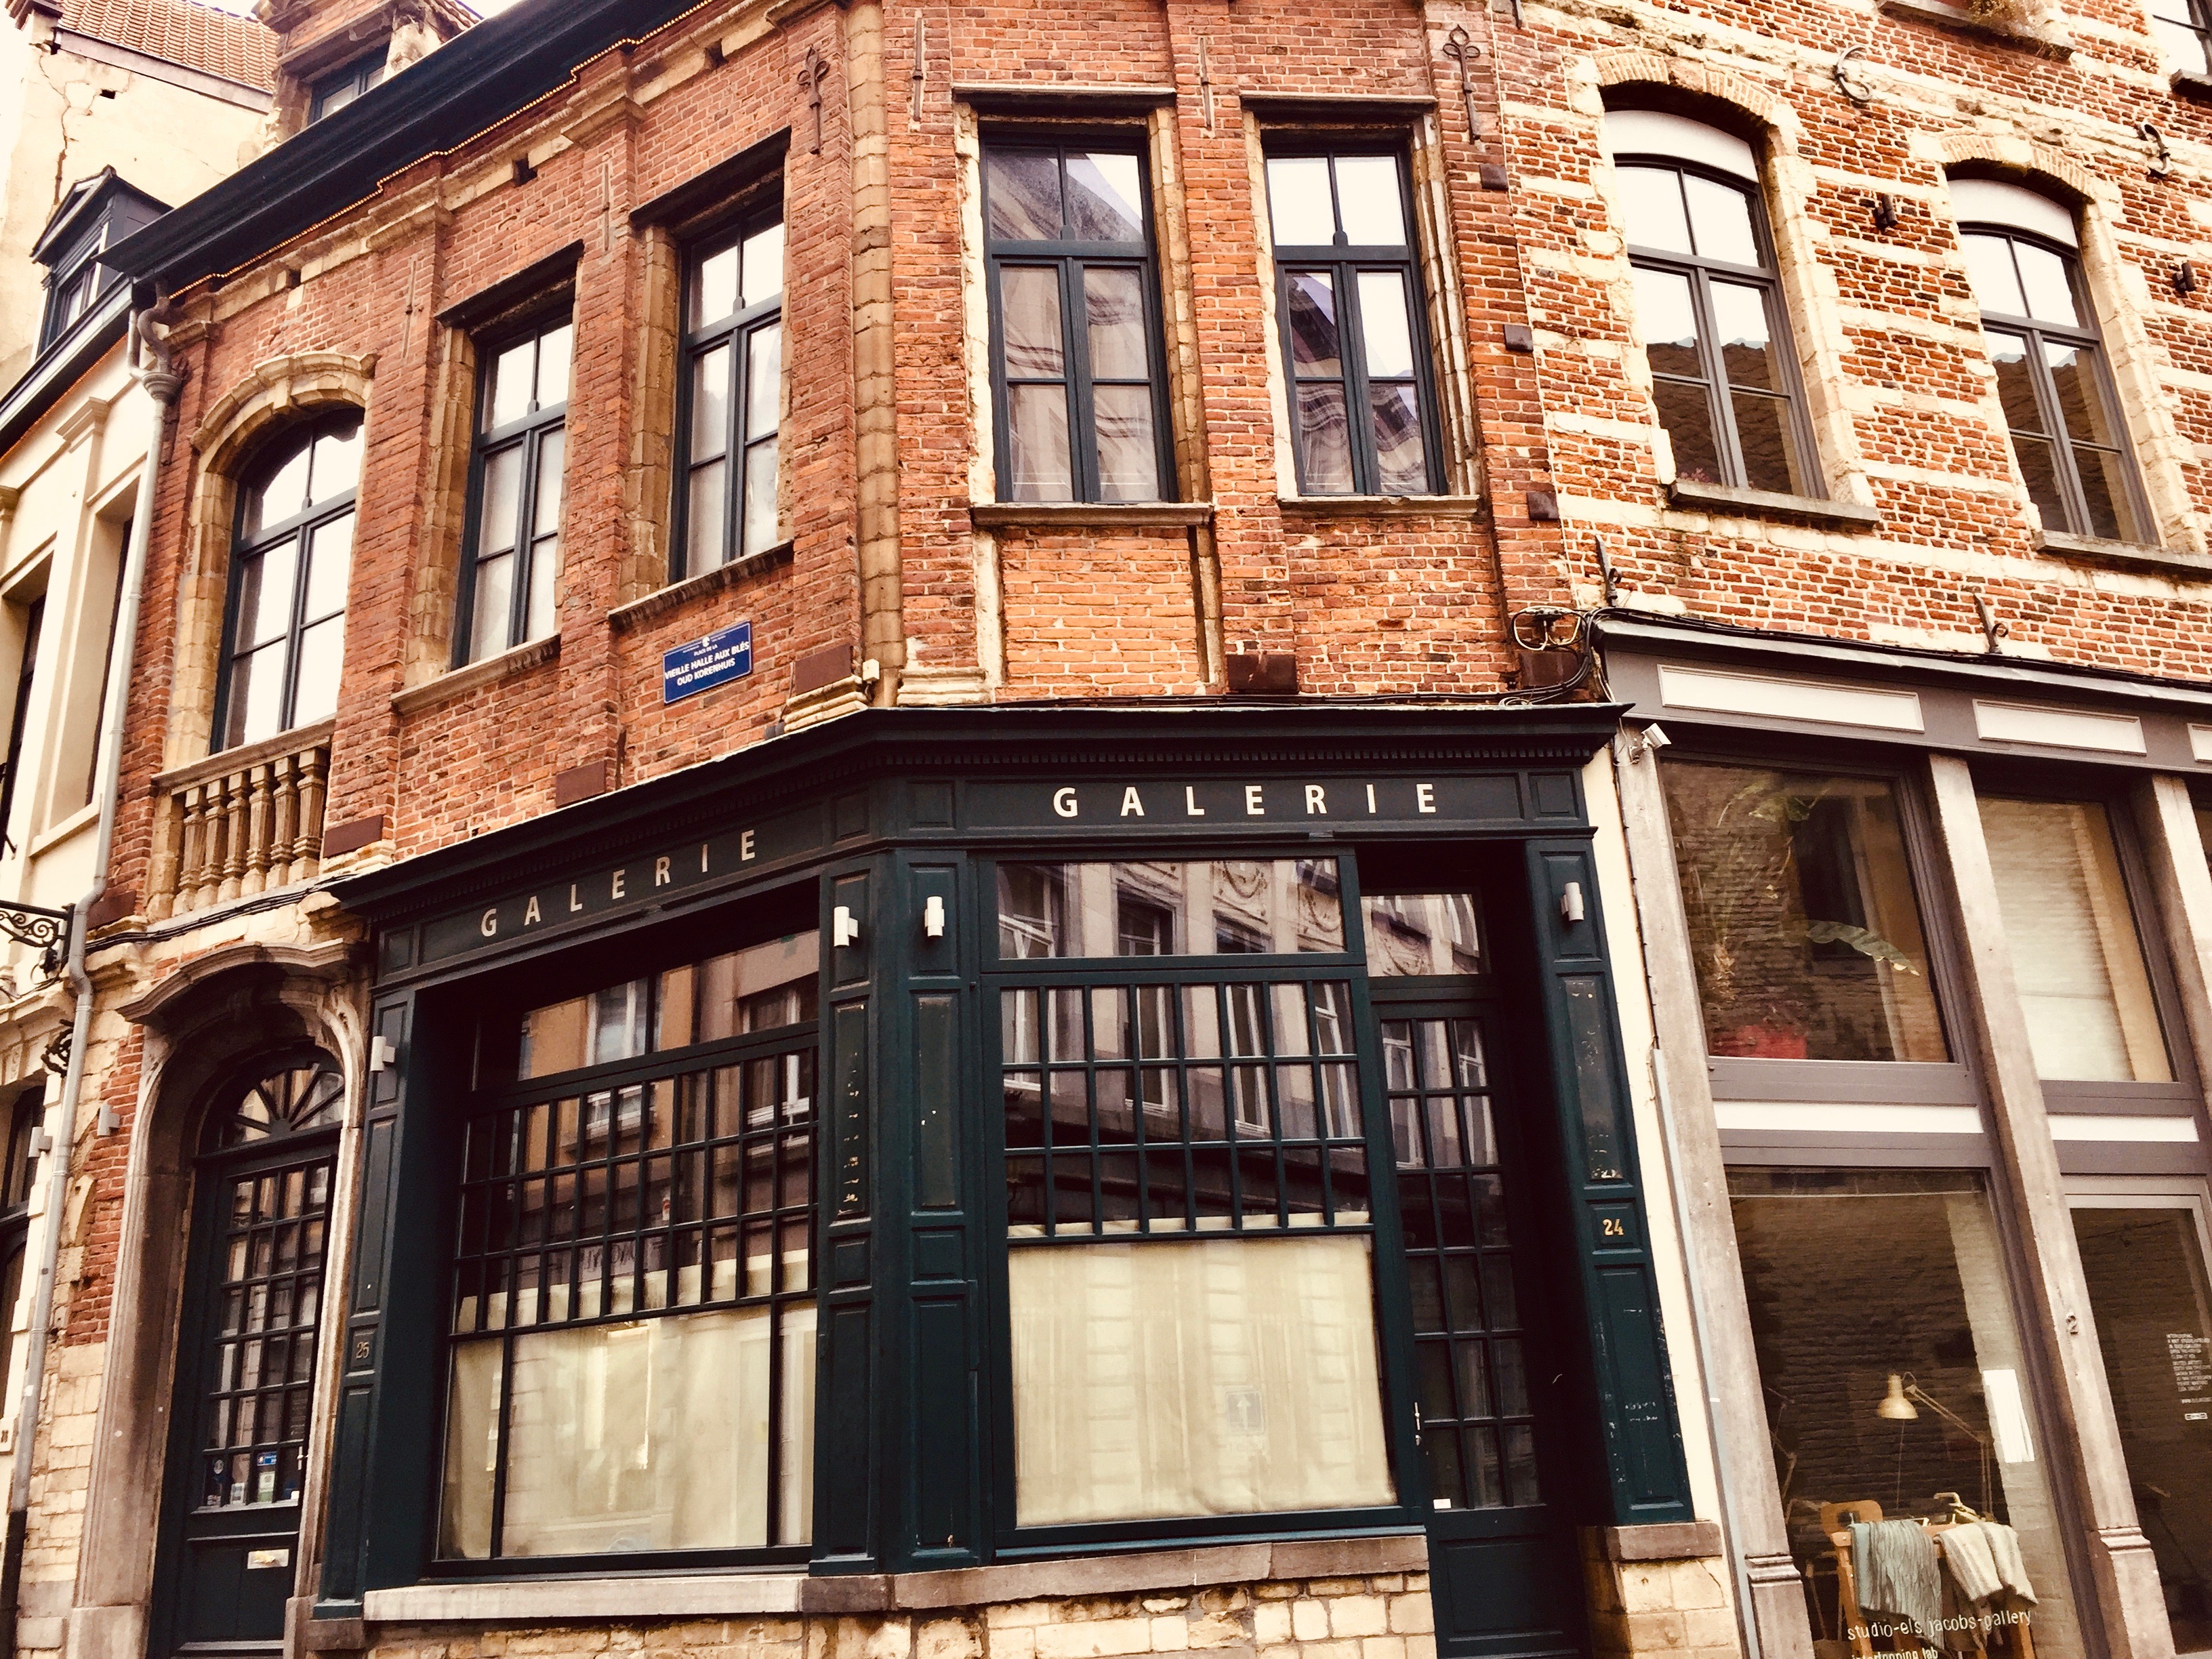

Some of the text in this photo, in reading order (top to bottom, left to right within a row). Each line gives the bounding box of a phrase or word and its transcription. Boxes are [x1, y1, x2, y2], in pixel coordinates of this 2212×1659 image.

[664, 663, 690, 680] VIEILLE
[691, 655, 714, 670] HALLE
[714, 648, 731, 661] AUX
[731, 640, 750, 655] BLÉS
[676, 657, 736, 687] OUD KORENHUIS
[1052, 783, 1437, 818] GALERIE
[480, 829, 756, 937] GALERIE
[1602, 1218, 1624, 1236] 24
[1847, 1610, 2032, 1641] studio-els jacobs-gallery
[1921, 1646, 1939, 1659] lab
